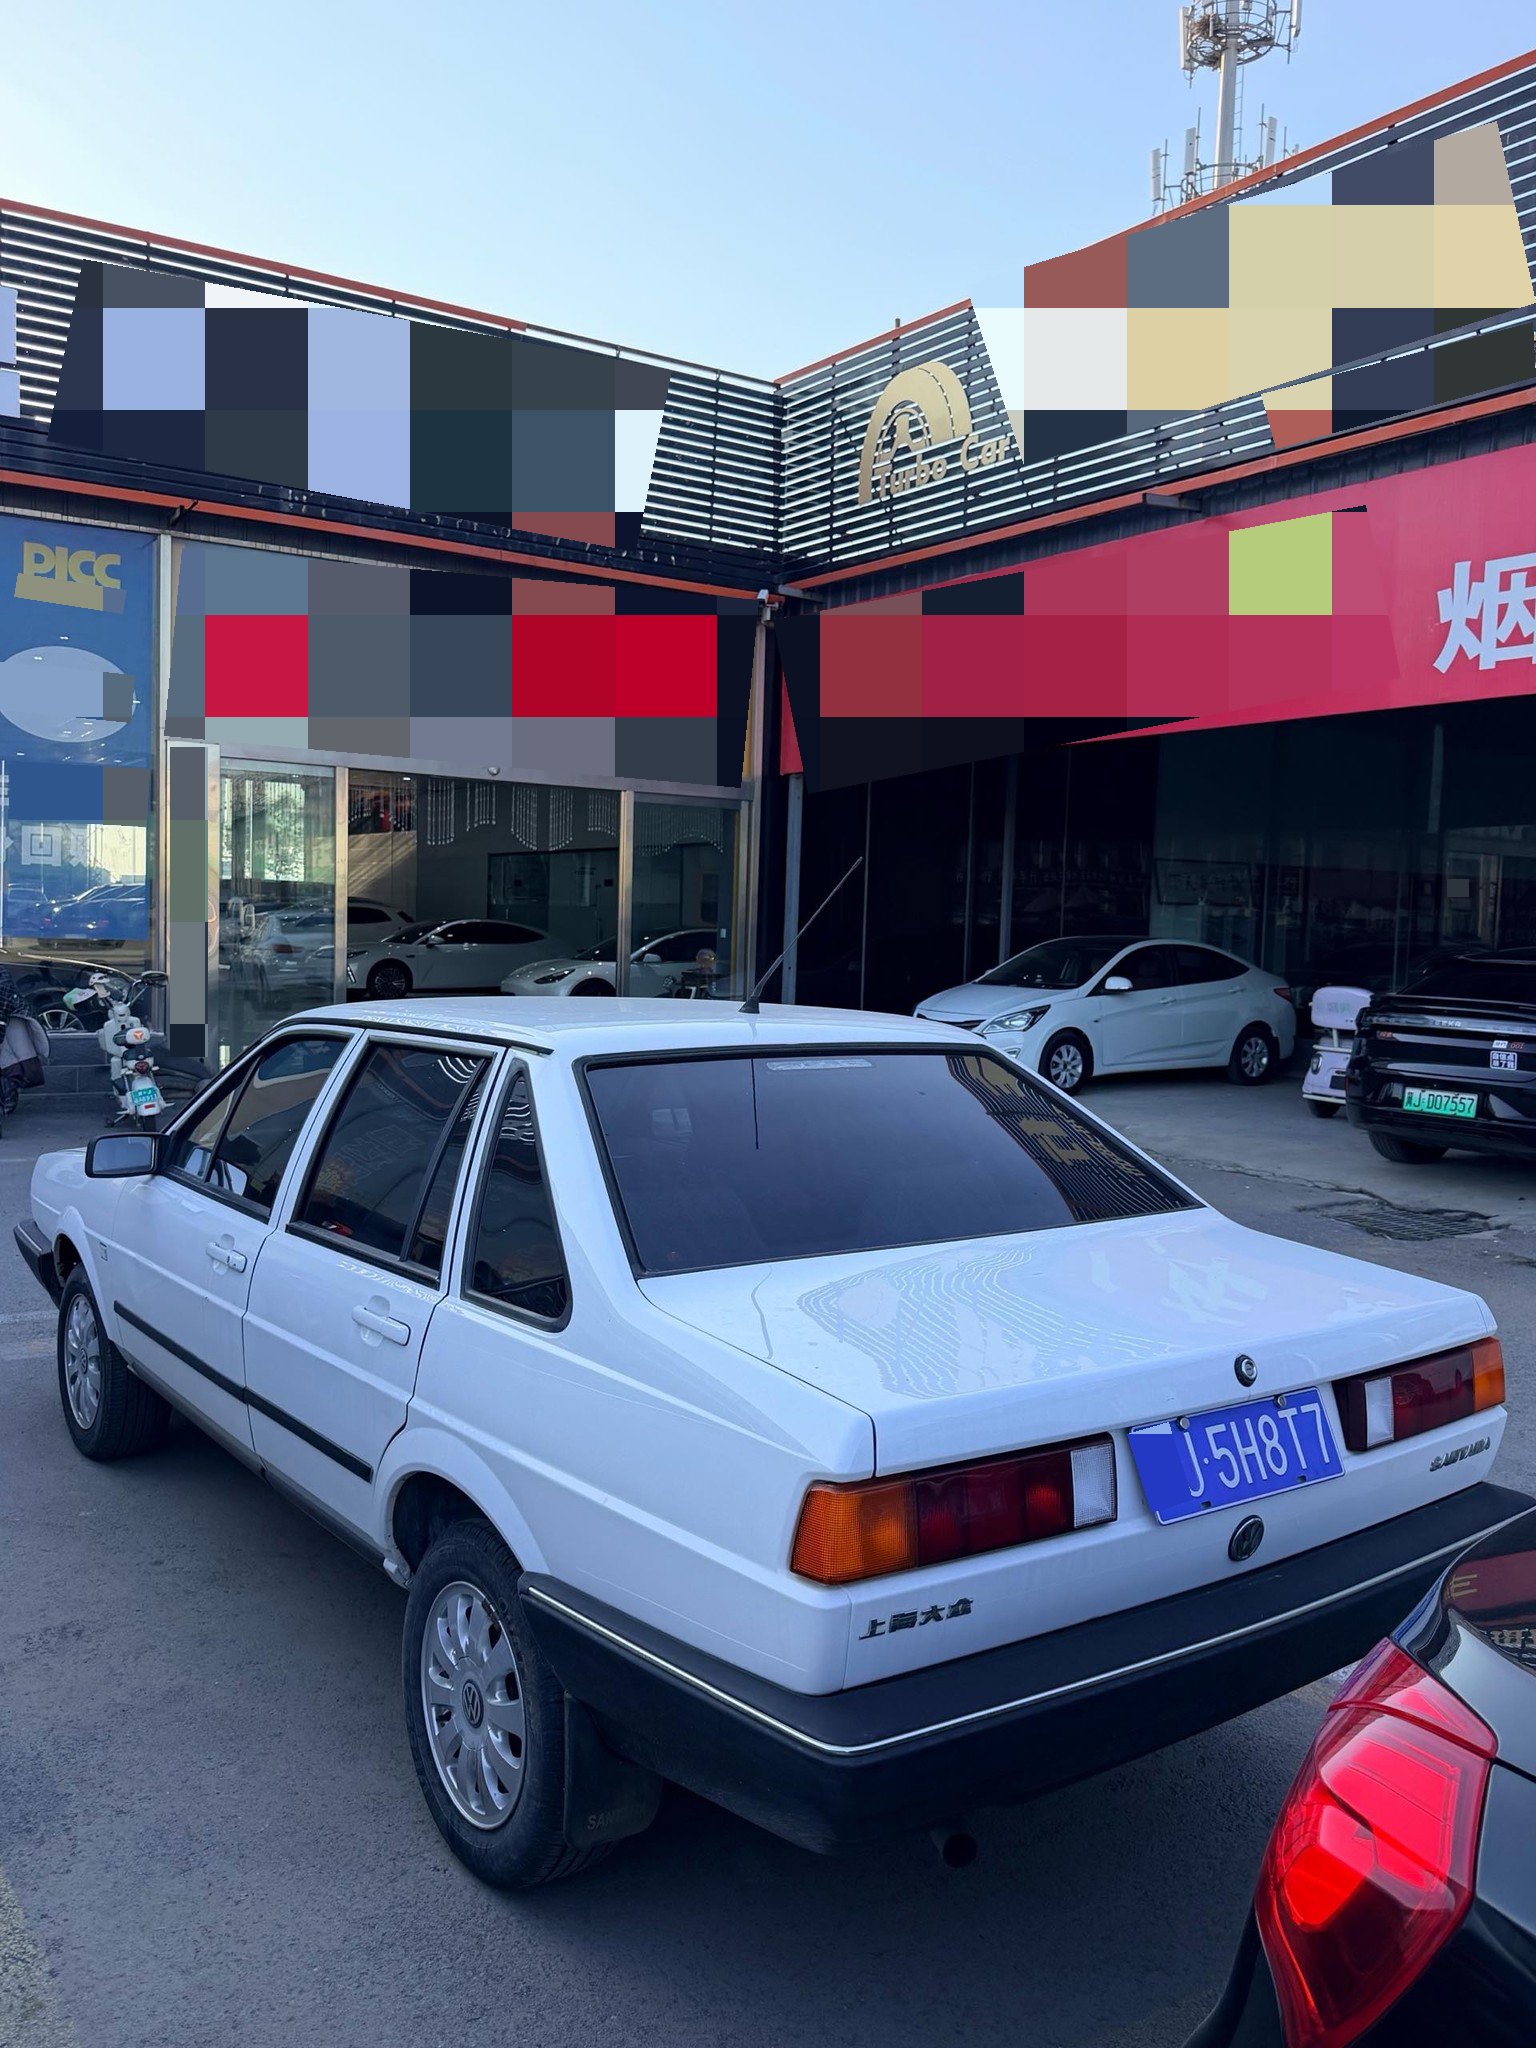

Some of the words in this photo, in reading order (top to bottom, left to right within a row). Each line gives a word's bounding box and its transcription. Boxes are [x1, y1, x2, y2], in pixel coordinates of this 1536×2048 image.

[874, 453, 947, 499] Turbo
[960, 434, 1010, 471] Car
[24, 541, 121, 589] PICC
[1432, 552, 1536, 674] 烟
